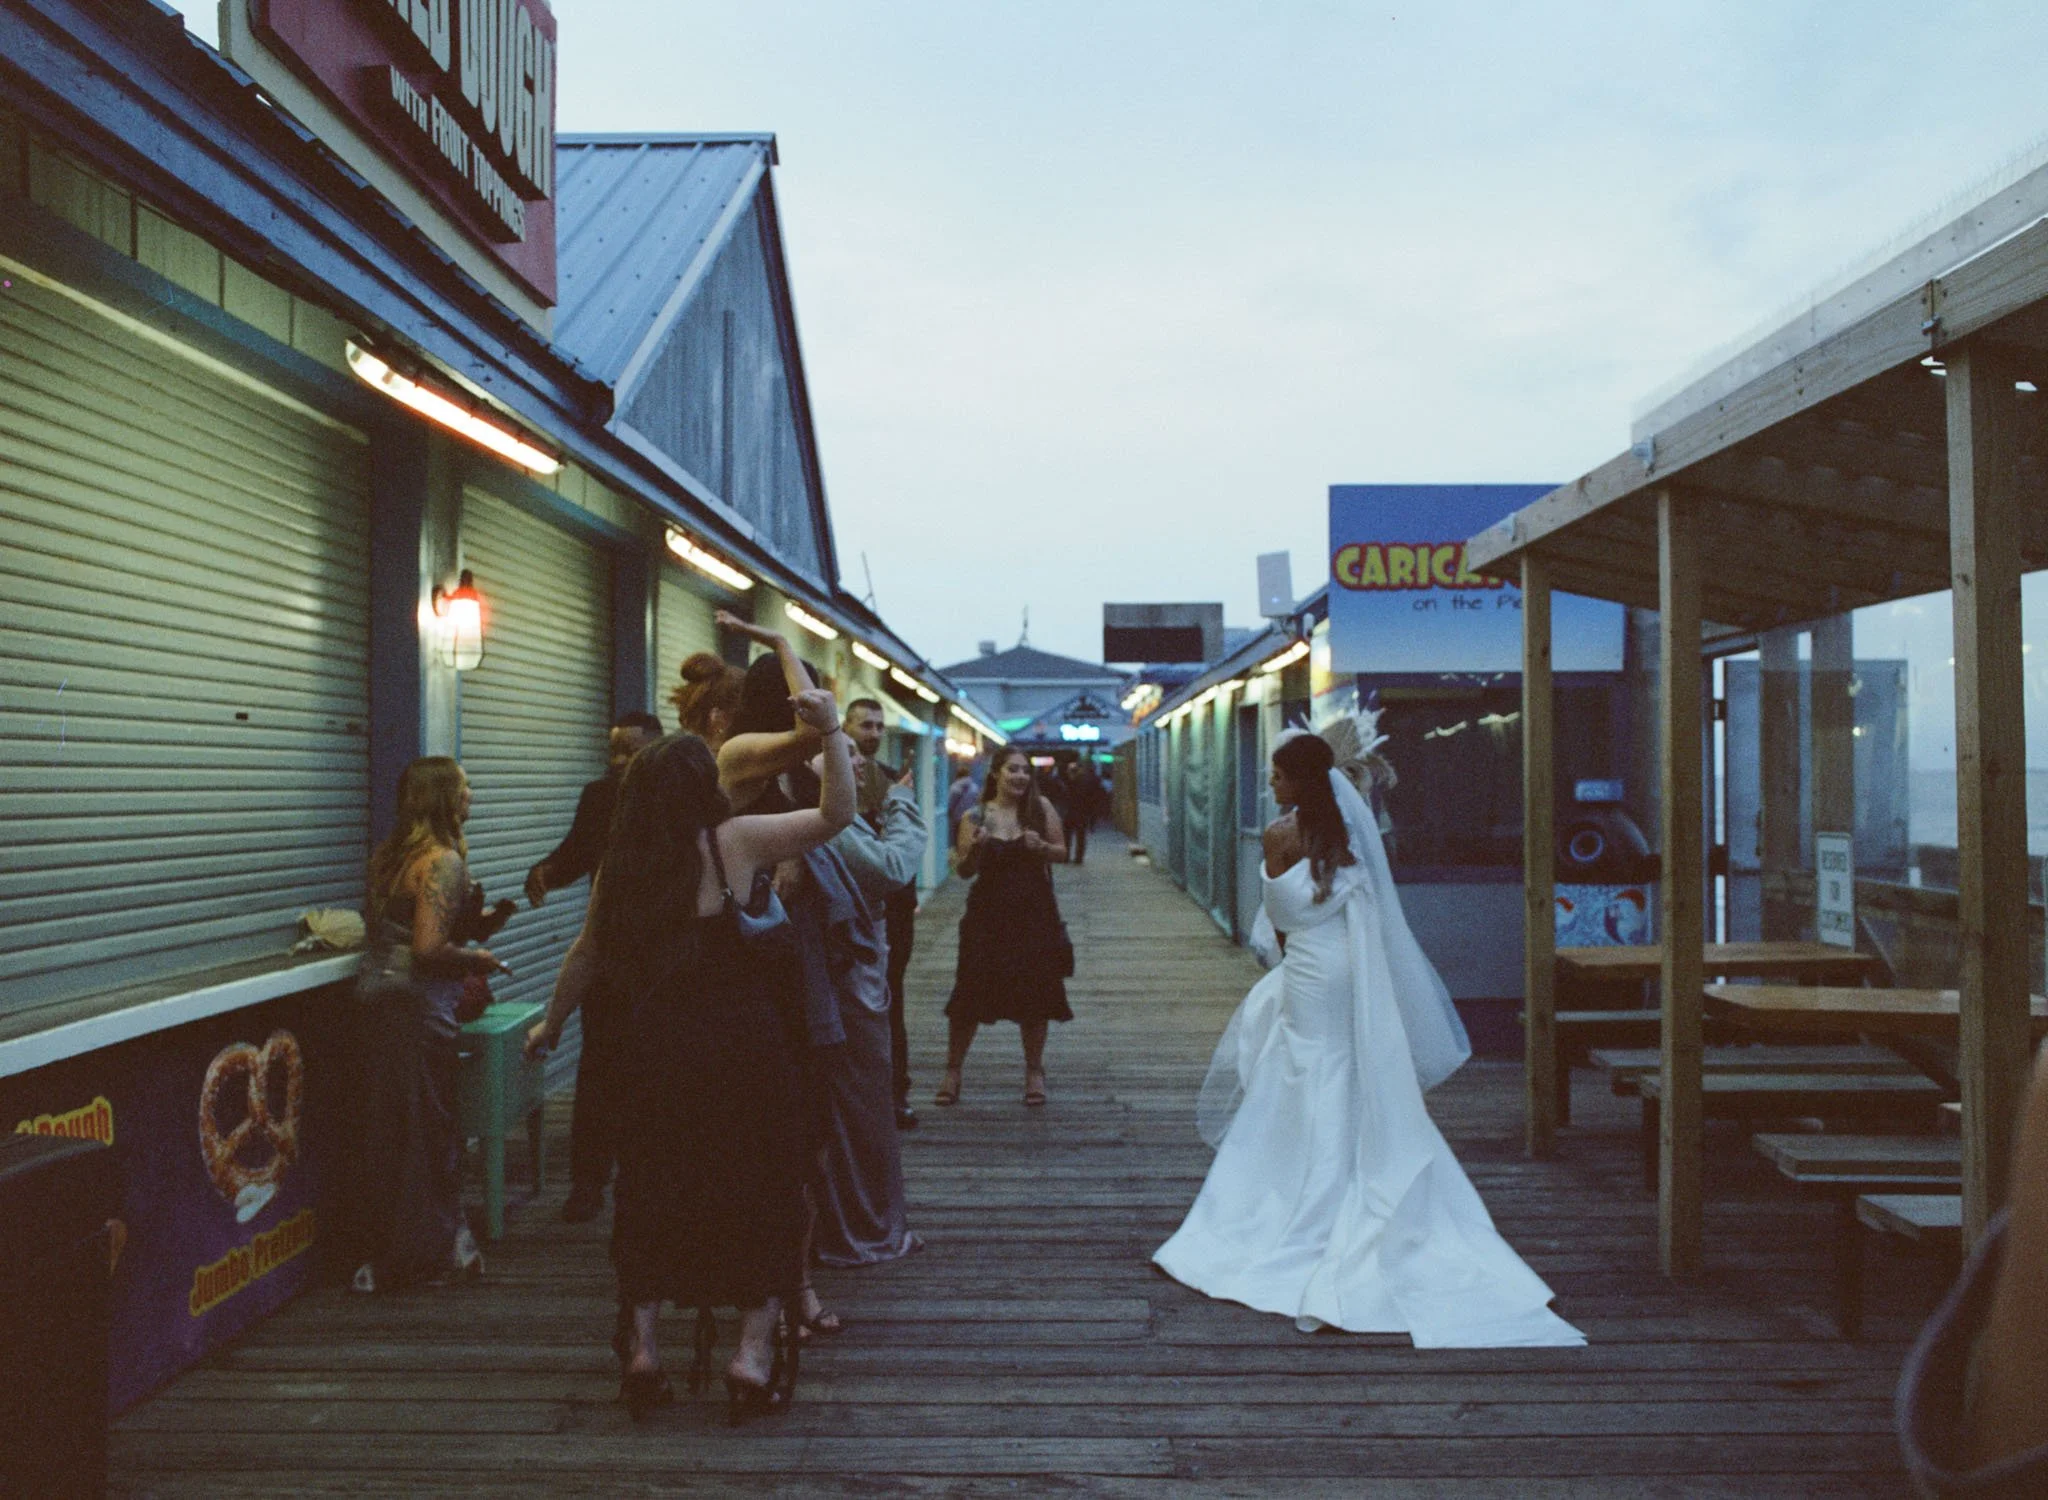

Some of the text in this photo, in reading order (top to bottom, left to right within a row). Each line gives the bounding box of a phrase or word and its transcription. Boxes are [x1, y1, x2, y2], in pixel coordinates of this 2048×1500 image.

[390, 64, 428, 133] WITH
[431, 94, 470, 179] FRUIT
[1334, 542, 1502, 590] CARIC
[1413, 598, 1437, 611] on
[1451, 594, 1483, 610] the
[188, 1237, 251, 1318] Jumbo
